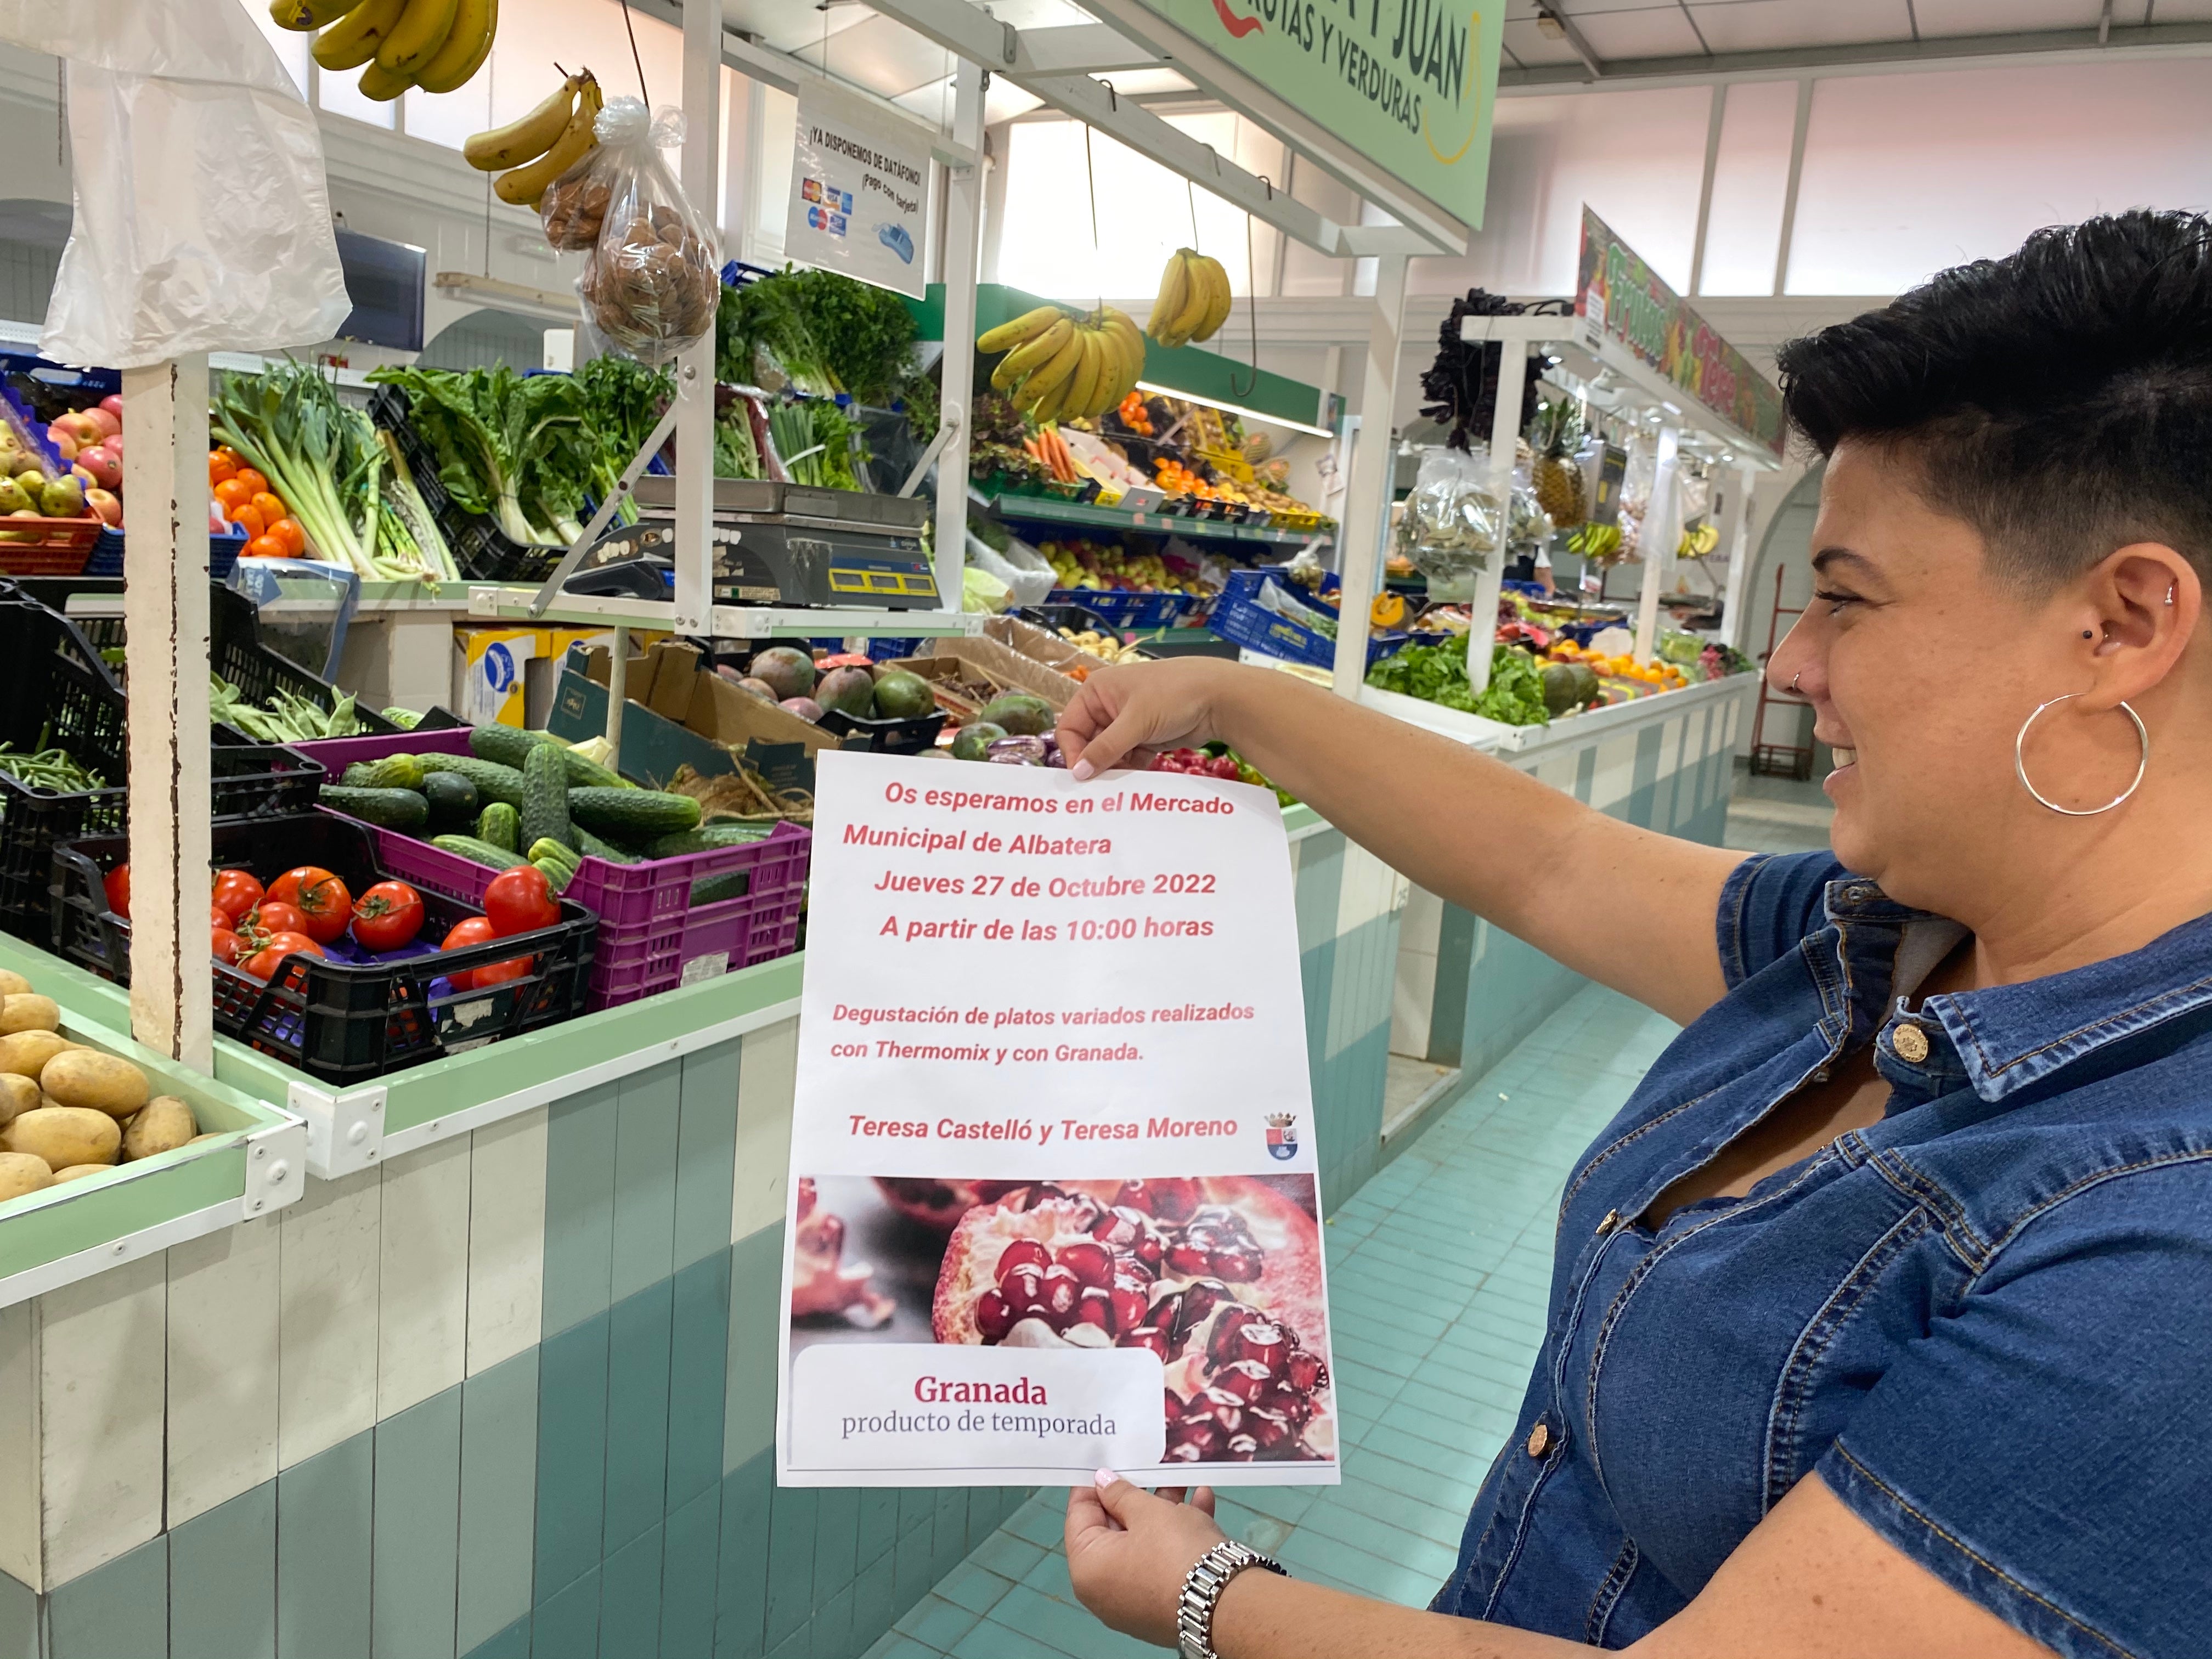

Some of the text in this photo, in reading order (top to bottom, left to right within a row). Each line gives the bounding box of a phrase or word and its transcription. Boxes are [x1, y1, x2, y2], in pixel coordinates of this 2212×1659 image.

[1392, 0, 1466, 114] JUAN
[1322, 16, 1334, 64] Y
[1339, 30, 1421, 134] VERDURAS
[825, 131, 872, 165] DISPONEMOS
[873, 151, 883, 170] DE
[862, 173, 919, 214] (Pago con tarjeta)
[885, 782, 1234, 815] Os esperamos en el Mercado
[843, 824, 1111, 855] Municipal de Albatera
[874, 871, 1216, 898] Jueves 27 de Octubre 2022
[880, 915, 1213, 942] A partir de las 10:00 horas
[833, 1003, 1254, 1029] Degustación de platos variados realizados
[831, 1041, 1143, 1065] con Thermomix y con Granada.
[850, 1115, 1238, 1146] Teresa Castelló y Teresa Moreno
[914, 1376, 1047, 1406] Granada
[842, 1410, 1115, 1438] producto de temporada
